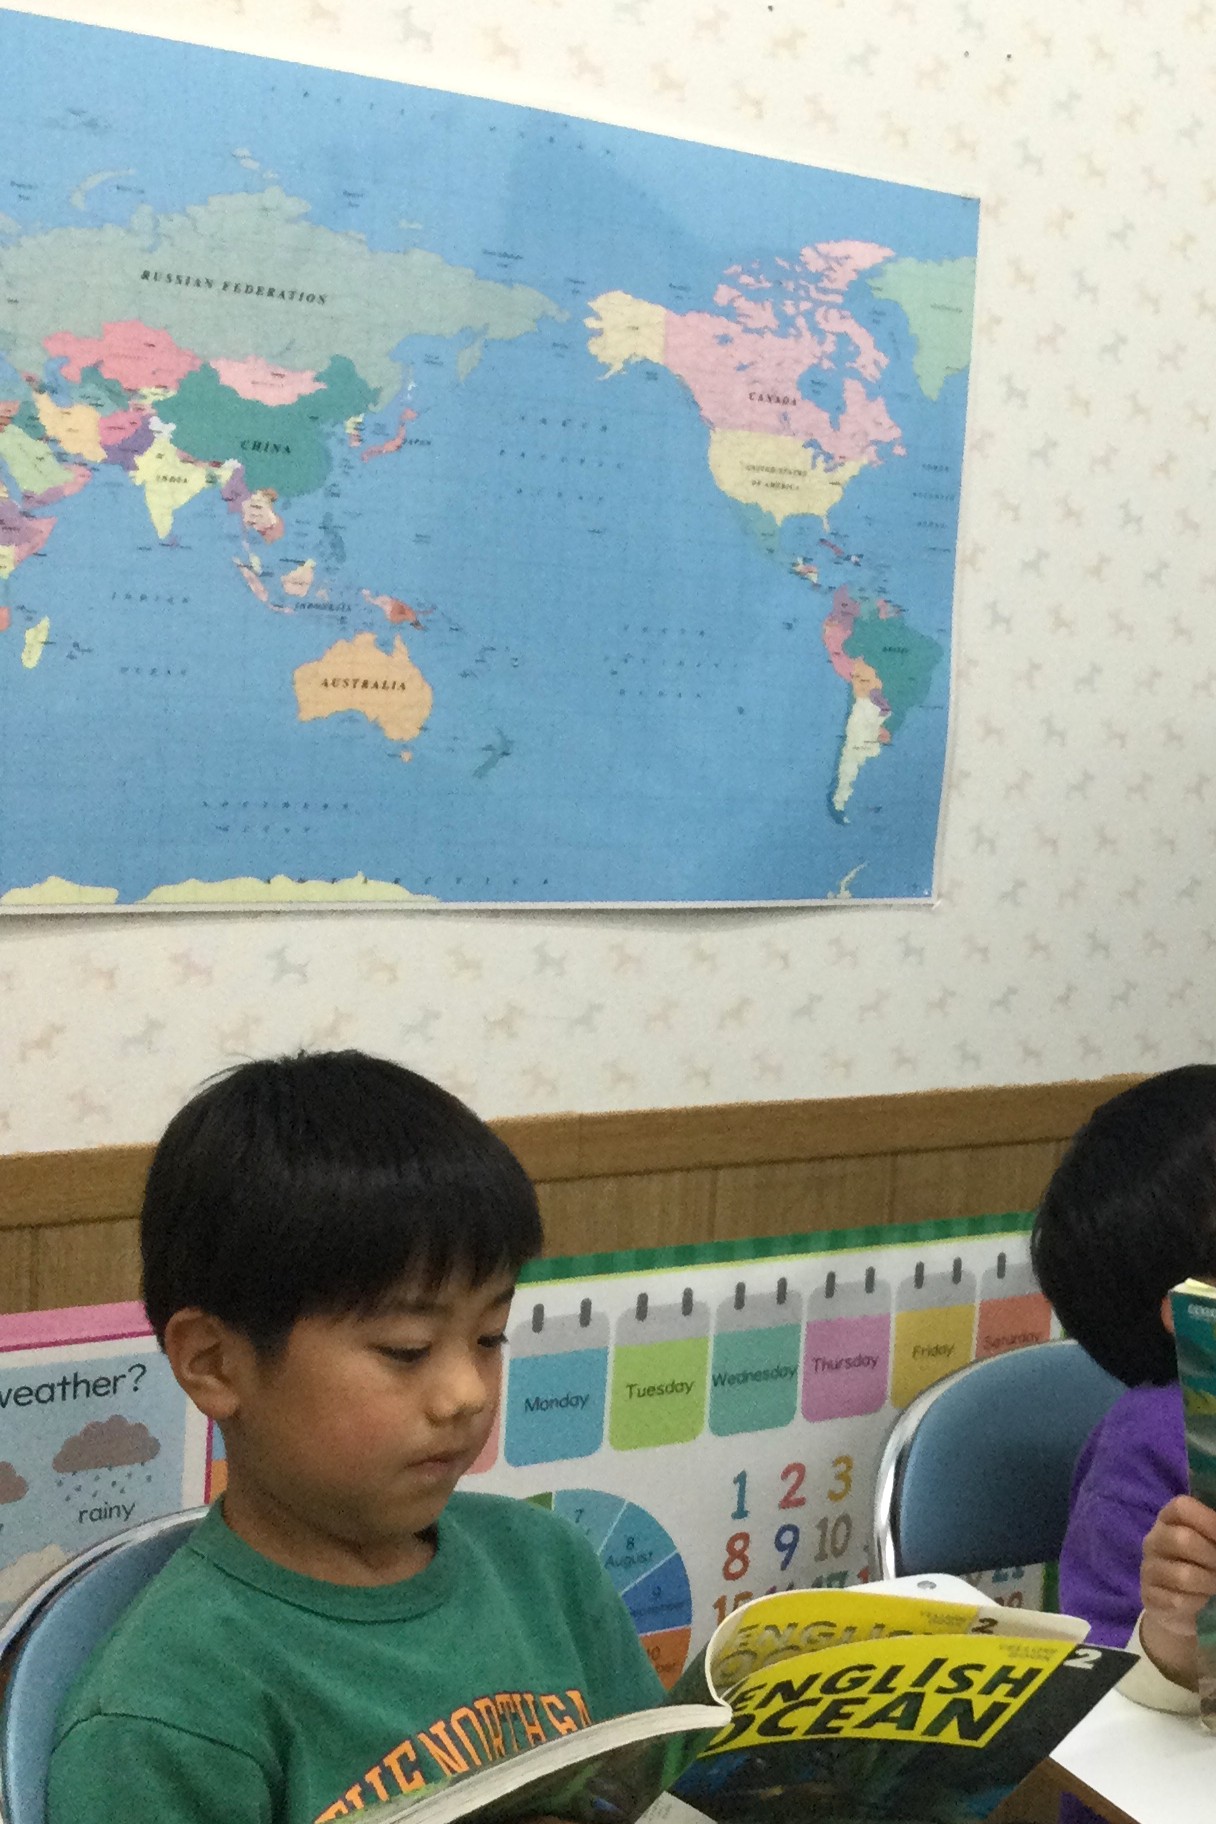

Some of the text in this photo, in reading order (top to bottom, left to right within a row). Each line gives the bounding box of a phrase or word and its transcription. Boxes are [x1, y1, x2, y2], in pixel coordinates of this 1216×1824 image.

[140, 269, 328, 305] RUSSIAN FEDERATION
[748, 391, 797, 406] CANADA
[240, 439, 292, 454] CHINA
[321, 677, 407, 692] AUSTRALIA
[911, 1342, 955, 1360] Friday
[982, 1330, 1042, 1351] Saturday
[812, 1352, 880, 1374] Thursday
[711, 1363, 799, 1388] Wednesday
[626, 1379, 697, 1400] Tuesday
[524, 1391, 591, 1413] Monday
[731, 1455, 854, 1520] 1 2 3
[77, 1500, 136, 1524] rainy
[574, 1508, 584, 1524] 7
[624, 1535, 636, 1550] 8
[722, 1512, 853, 1582] 8 9 10
[603, 1551, 654, 1570] August
[971, 1617, 999, 1634] 2
[1063, 1648, 1102, 1670] 2
[730, 1657, 1044, 1713] ENGLISH
[416, 1691, 546, 1779] NORTH
